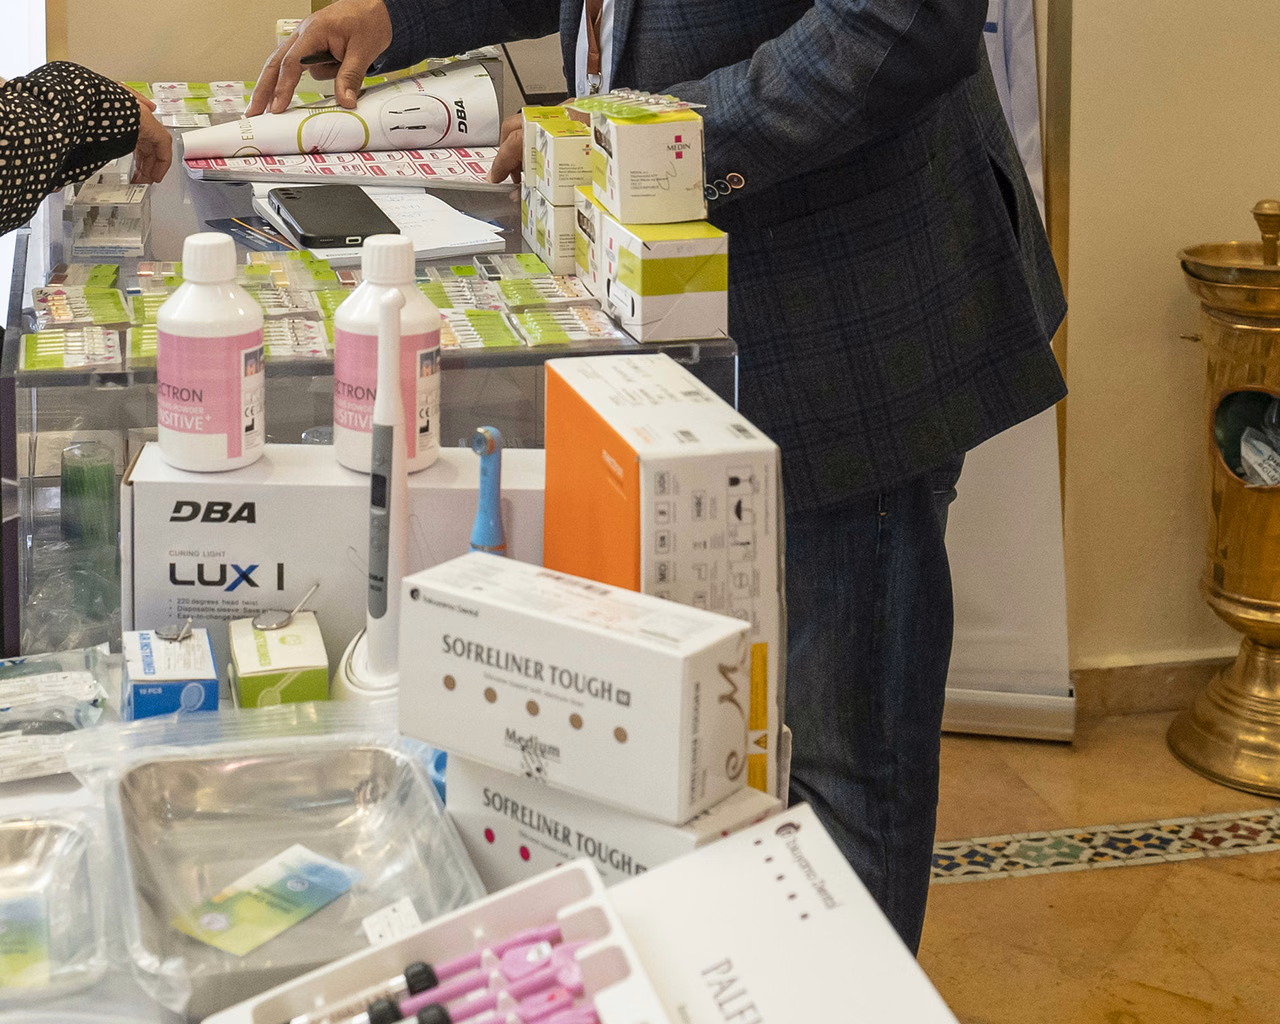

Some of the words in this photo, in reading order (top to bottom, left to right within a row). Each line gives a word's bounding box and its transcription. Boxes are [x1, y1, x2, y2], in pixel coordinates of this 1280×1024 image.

[454, 99, 468, 134] DBA
[169, 500, 257, 524] DBA
[203, 550, 226, 558] LIGHT
[169, 562, 260, 592] LUX
[442, 634, 544, 681] SOFRELINER
[549, 665, 613, 702] TOUGH
[504, 727, 561, 758] Medium
[482, 787, 572, 846] SOFRELINER
[576, 832, 632, 875] TOUGH
